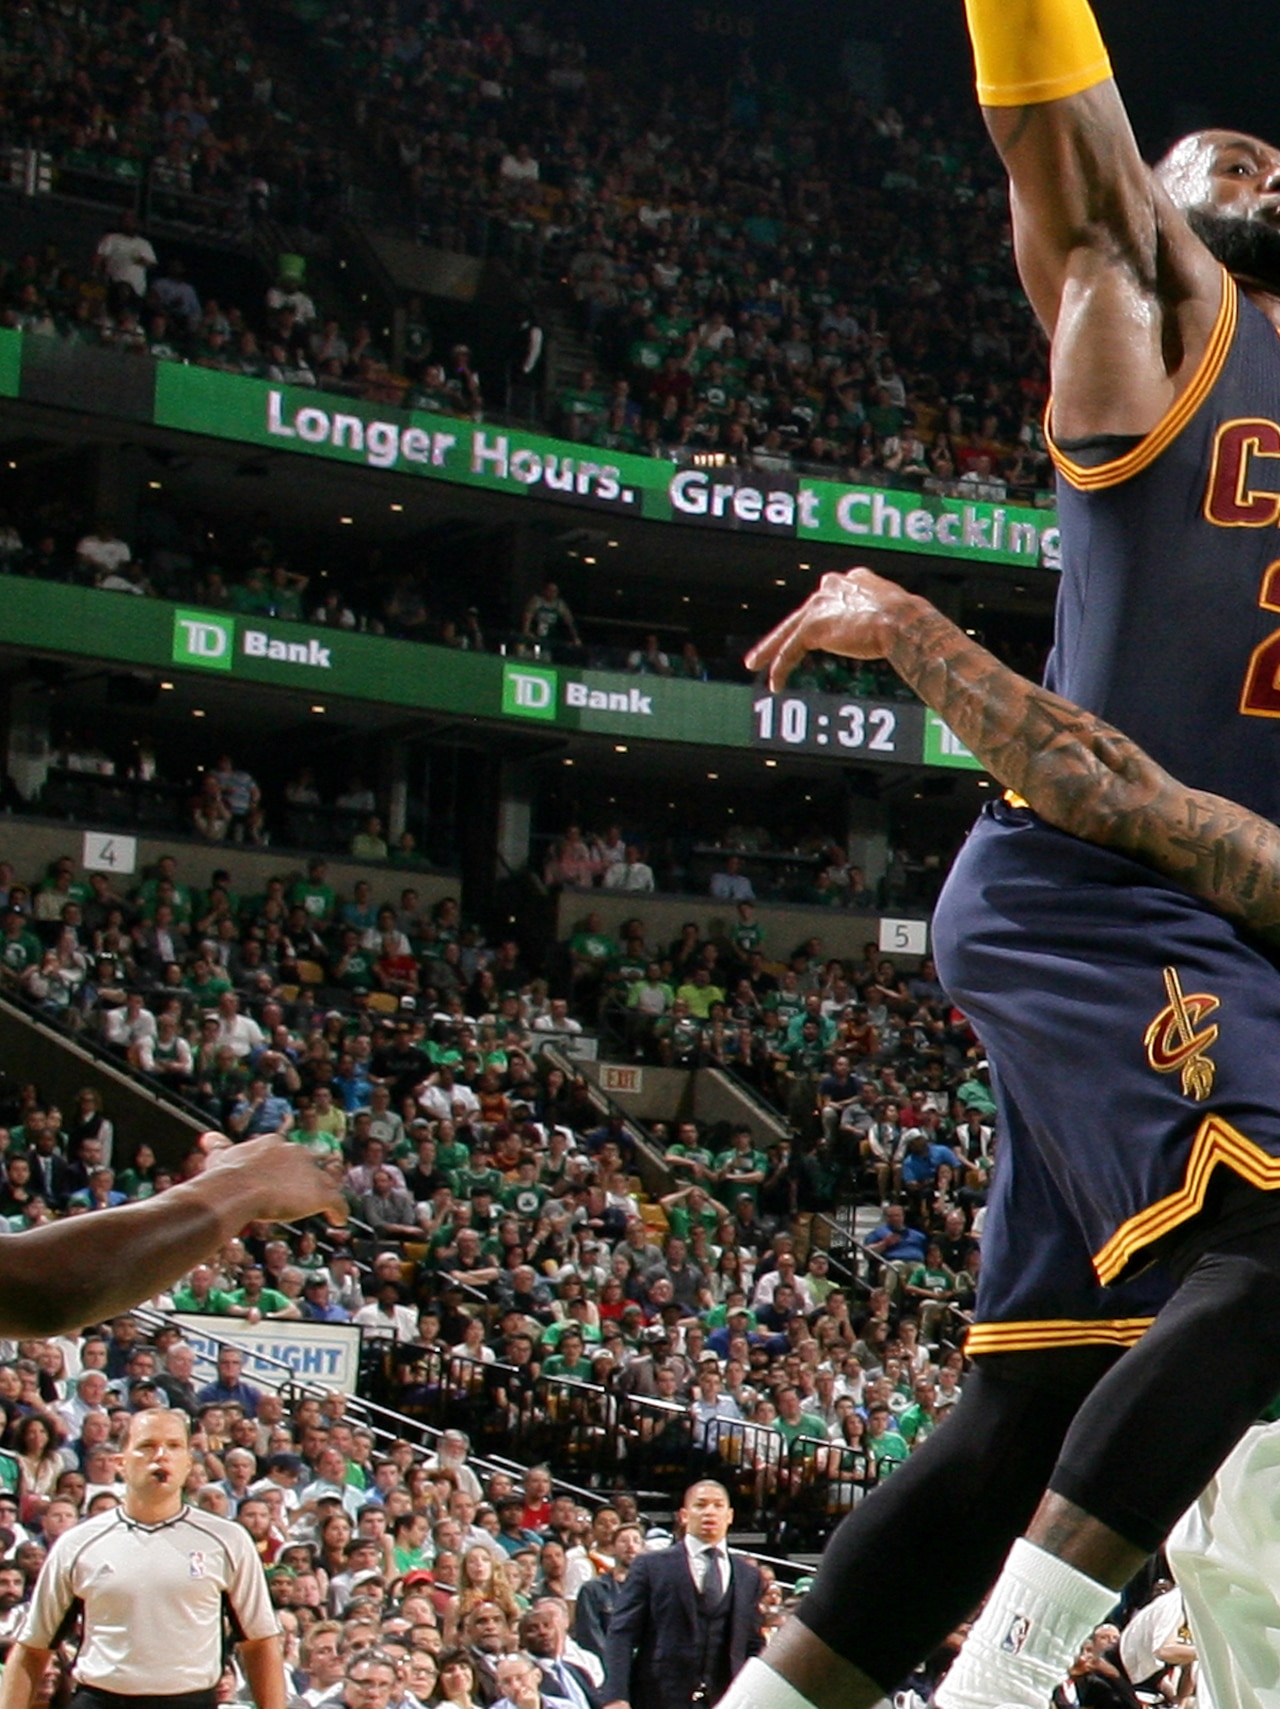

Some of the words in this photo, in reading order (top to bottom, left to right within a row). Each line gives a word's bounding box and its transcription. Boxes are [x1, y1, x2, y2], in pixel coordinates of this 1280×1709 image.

[267, 390, 456, 467] Longer
[471, 431, 635, 503] Hours.
[670, 470, 819, 529] Great
[836, 493, 1061, 569] Checking
[180, 618, 228, 658] TD
[243, 629, 332, 668] Bank
[508, 672, 551, 709] TD
[565, 682, 653, 715] Bank
[754, 697, 896, 752] 10:32
[99, 838, 115, 867] 4
[895, 924, 909, 948] 5
[607, 1067, 636, 1089] EXIT
[255, 1341, 343, 1374] LIGHT
